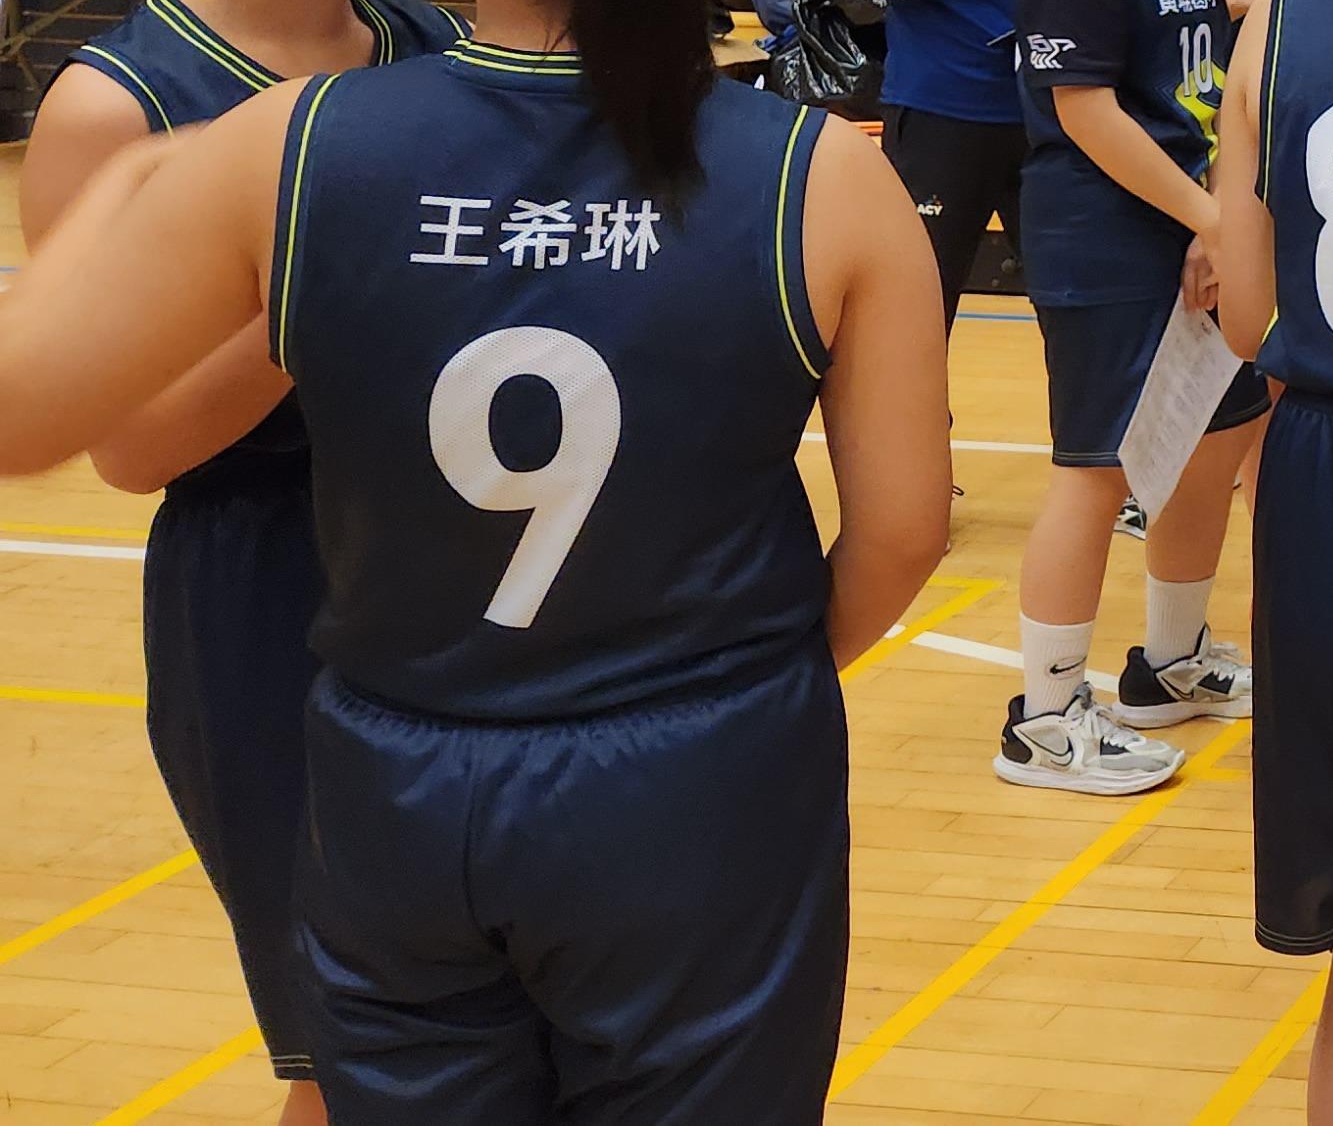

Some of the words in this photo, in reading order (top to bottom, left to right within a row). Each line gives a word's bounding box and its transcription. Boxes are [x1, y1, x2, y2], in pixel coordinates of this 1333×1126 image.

[1179, 23, 1214, 97] 10
[409, 195, 661, 271] 王希琳
[916, 203, 944, 216] ACY
[428, 325, 622, 629] 9
